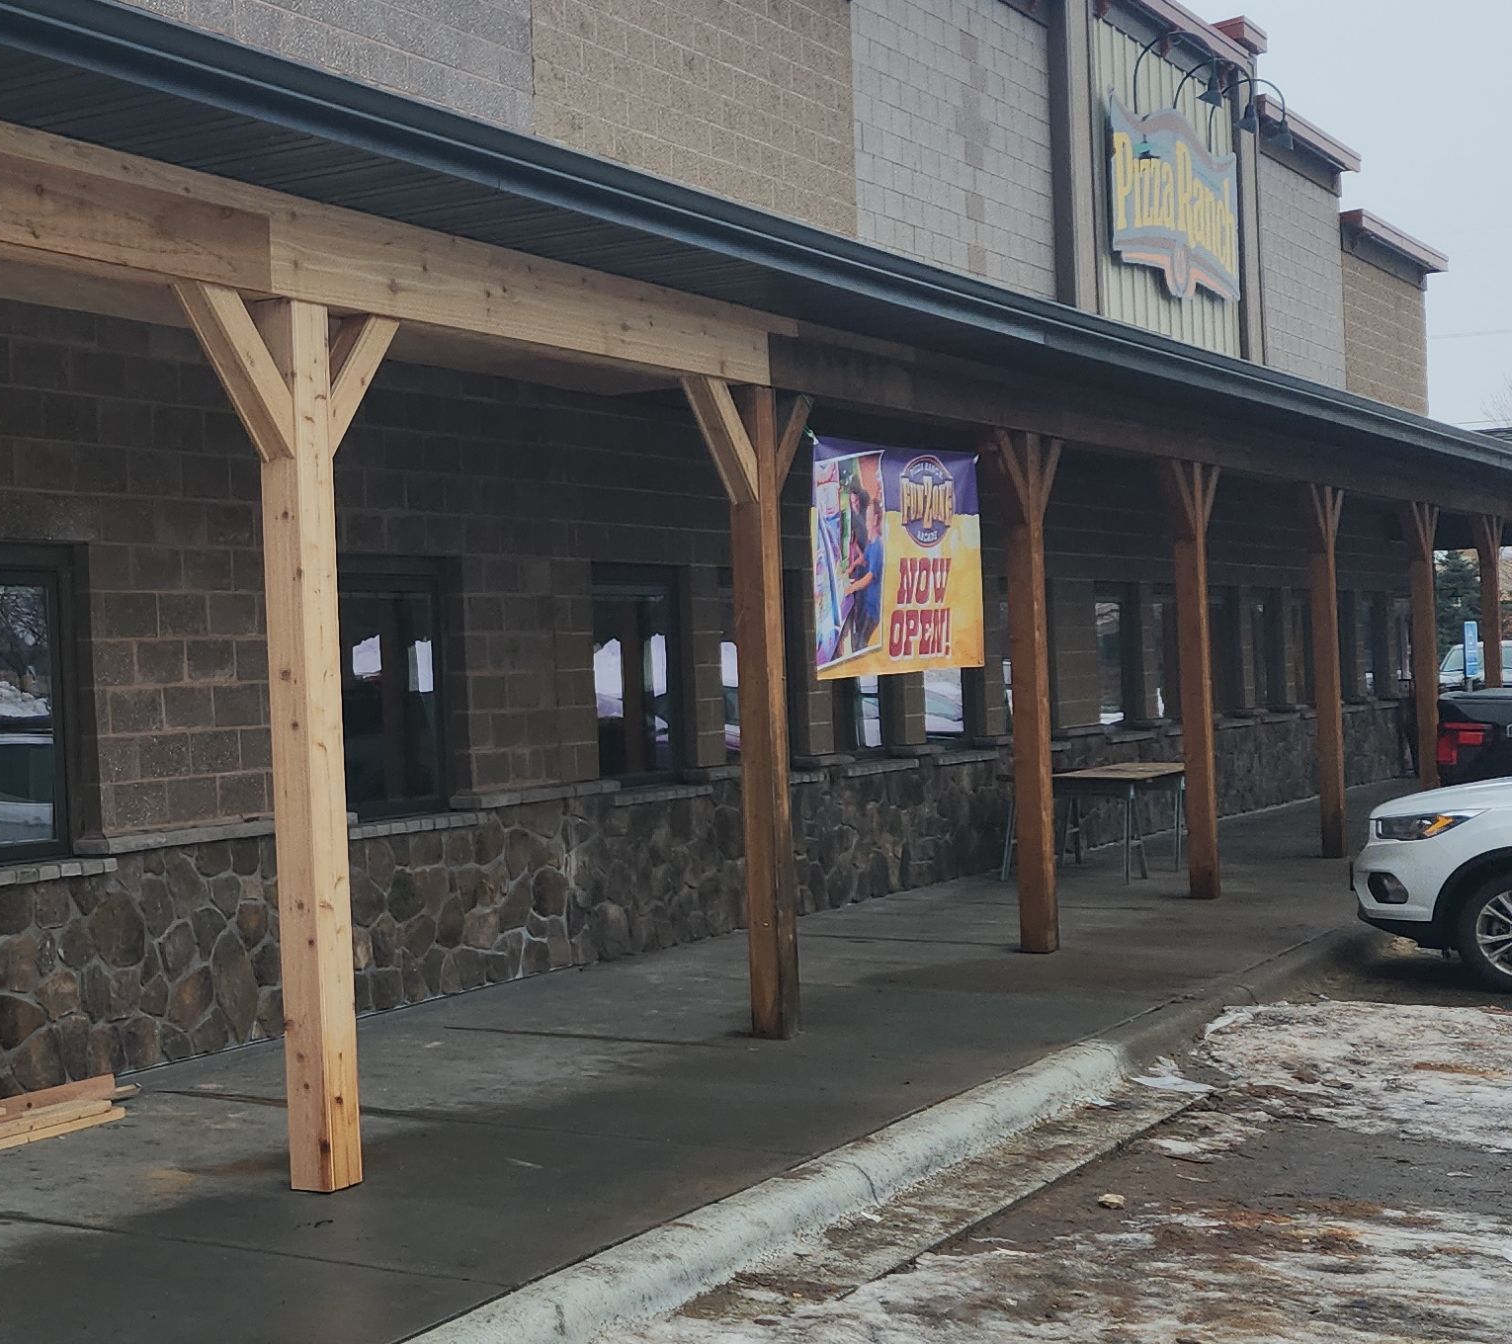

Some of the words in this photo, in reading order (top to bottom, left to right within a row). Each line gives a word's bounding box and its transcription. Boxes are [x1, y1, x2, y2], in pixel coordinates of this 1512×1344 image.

[1113, 131, 1176, 233] Pizza
[1175, 139, 1236, 278] Ranch
[896, 557, 952, 606] NOW
[888, 607, 951, 658] OPEN!
